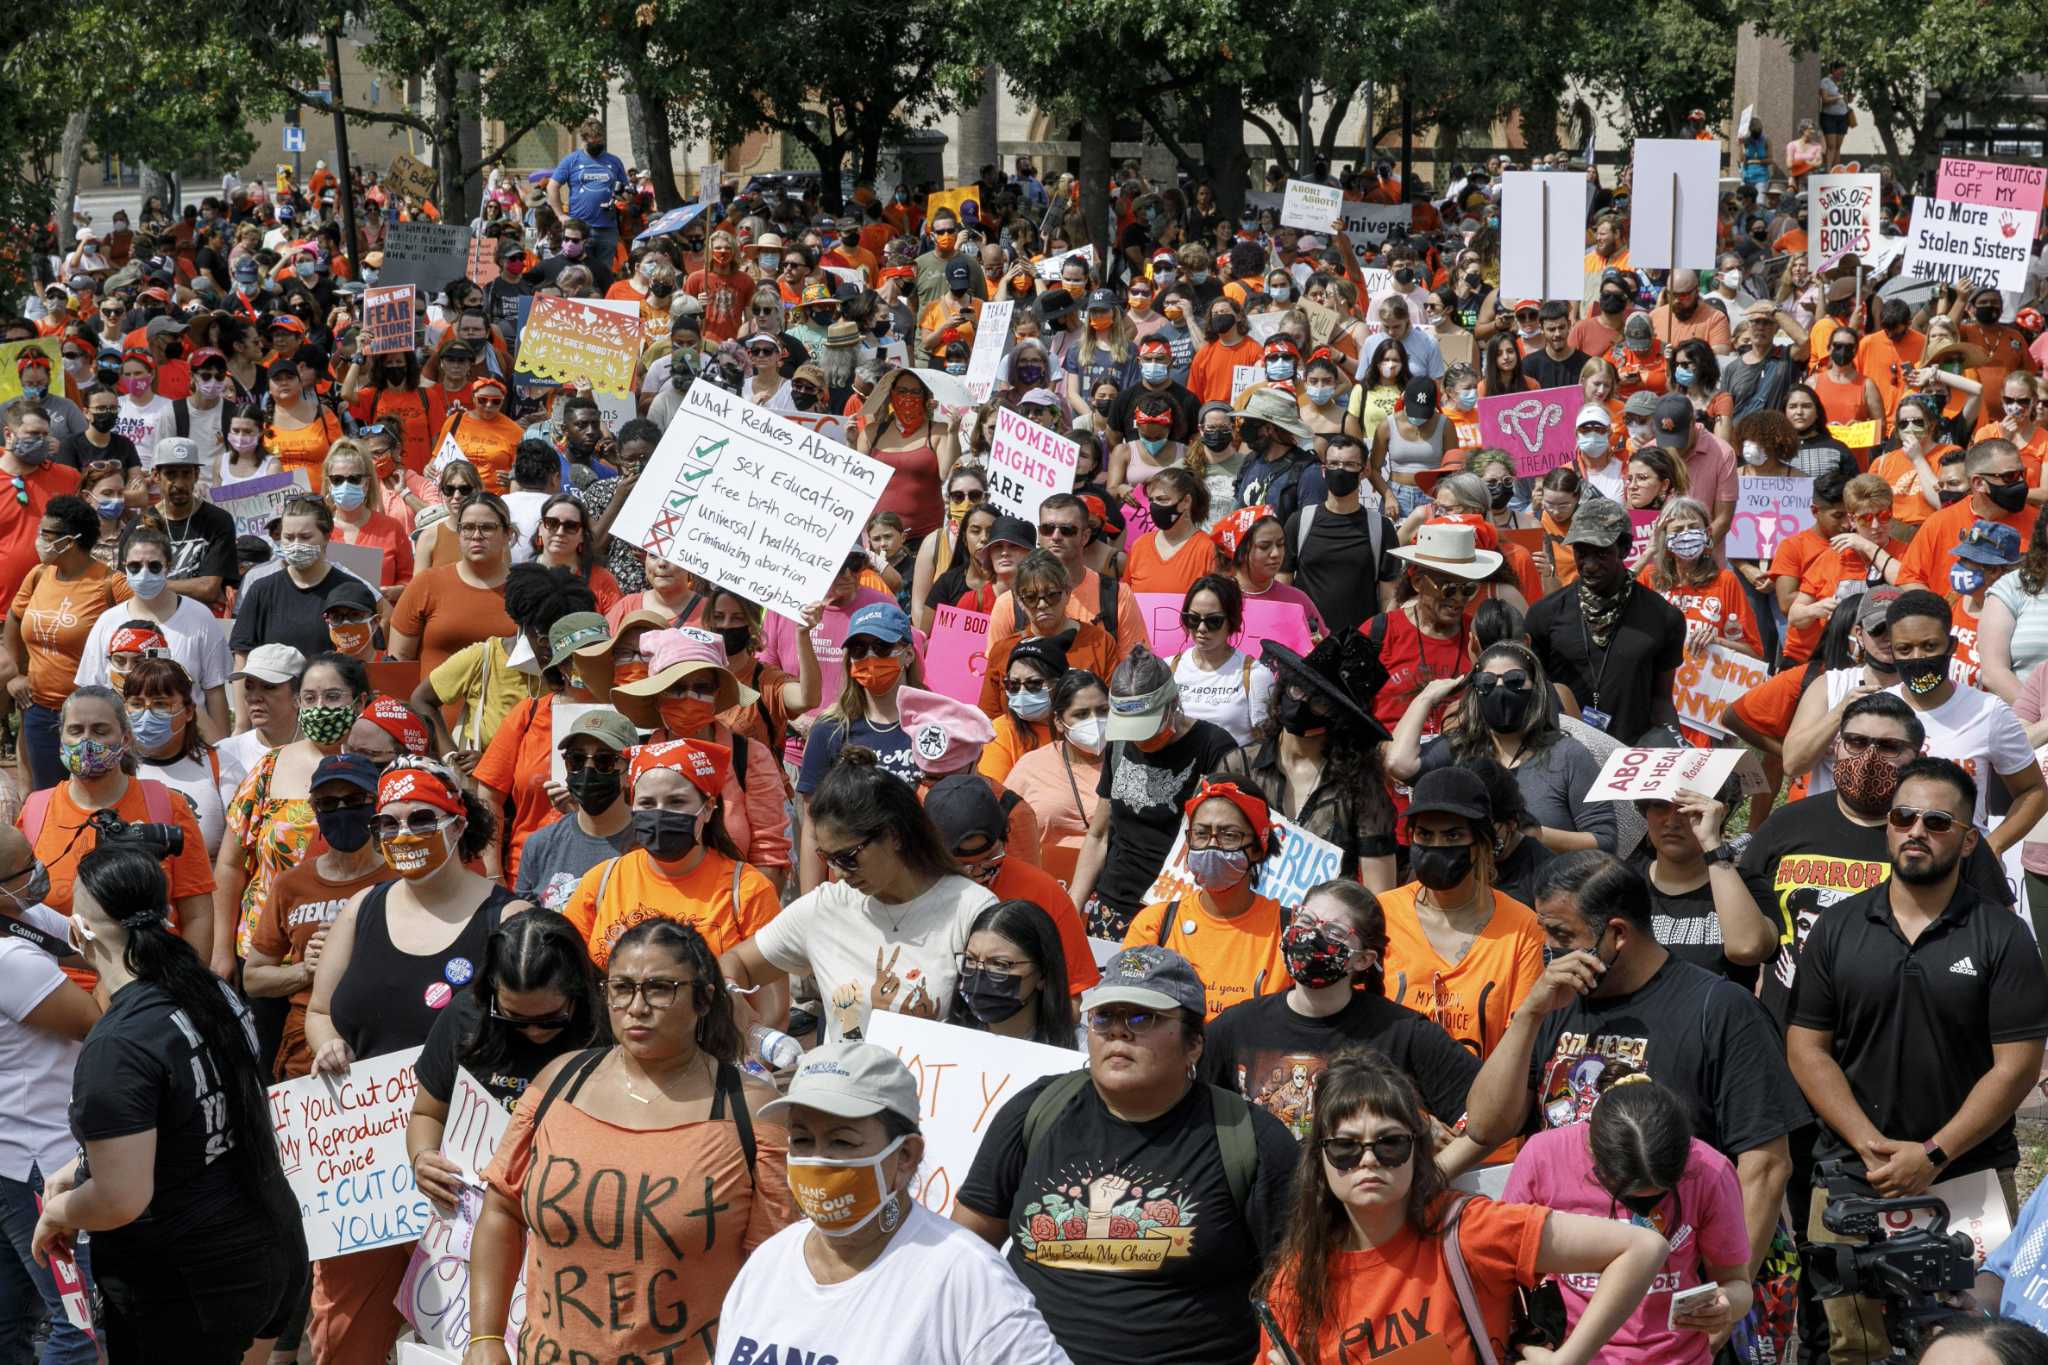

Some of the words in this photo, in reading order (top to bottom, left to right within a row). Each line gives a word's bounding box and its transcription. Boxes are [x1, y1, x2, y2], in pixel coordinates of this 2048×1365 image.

[286, 128, 303, 151] H
[1944, 161, 1976, 177] KEEP
[1994, 165, 2042, 185] POLITICS
[1818, 188, 1847, 210] BANS
[1850, 188, 1873, 208] OFF
[1954, 182, 1983, 198] OFF
[1996, 187, 2018, 202] MY
[1828, 209, 1862, 226] OUR
[1923, 199, 1945, 220] No
[1948, 202, 1989, 227] More
[1918, 229, 1970, 256] Stolen
[1972, 239, 2027, 262] Sisters
[366, 300, 411, 327] FEAR
[690, 389, 733, 421] What
[741, 408, 795, 447] Reduces
[798, 434, 876, 486] Abortion
[998, 410, 1076, 467] WOMEN'S
[993, 440, 1057, 488] RIGHTS
[1519, 453, 1556, 473] TREAD
[770, 471, 856, 524] Education
[989, 471, 1025, 504] ARE
[711, 476, 742, 502] free
[747, 492, 781, 519] birth
[783, 511, 837, 543] control
[1749, 495, 1770, 509] NO
[697, 502, 756, 541] universal
[759, 527, 834, 574] healthcare
[716, 566, 747, 587] your
[754, 551, 808, 586] abortion
[938, 610, 958, 629] MY
[963, 615, 990, 636] BOD
[1191, 685, 1240, 697] ABORTION
[1640, 779, 1661, 792] IS
[407, 847, 431, 858] OUR
[1776, 858, 1883, 889] HORROR
[9, 923, 44, 943] Canon
[1948, 965, 1978, 977] adidas
[1219, 983, 1248, 996] your
[490, 1071, 529, 1094] keep
[270, 1090, 293, 1133] If
[339, 1076, 384, 1111] Cut
[279, 1137, 302, 1167] My
[316, 1146, 376, 1186] Choice
[335, 1169, 387, 1207] CUT
[799, 1184, 827, 1199] BANS
[822, 1193, 856, 1212] OUR
[1039, 1241, 1062, 1261] My
[1096, 1242, 1119, 1263] My
[1120, 1242, 1163, 1263] Choice
